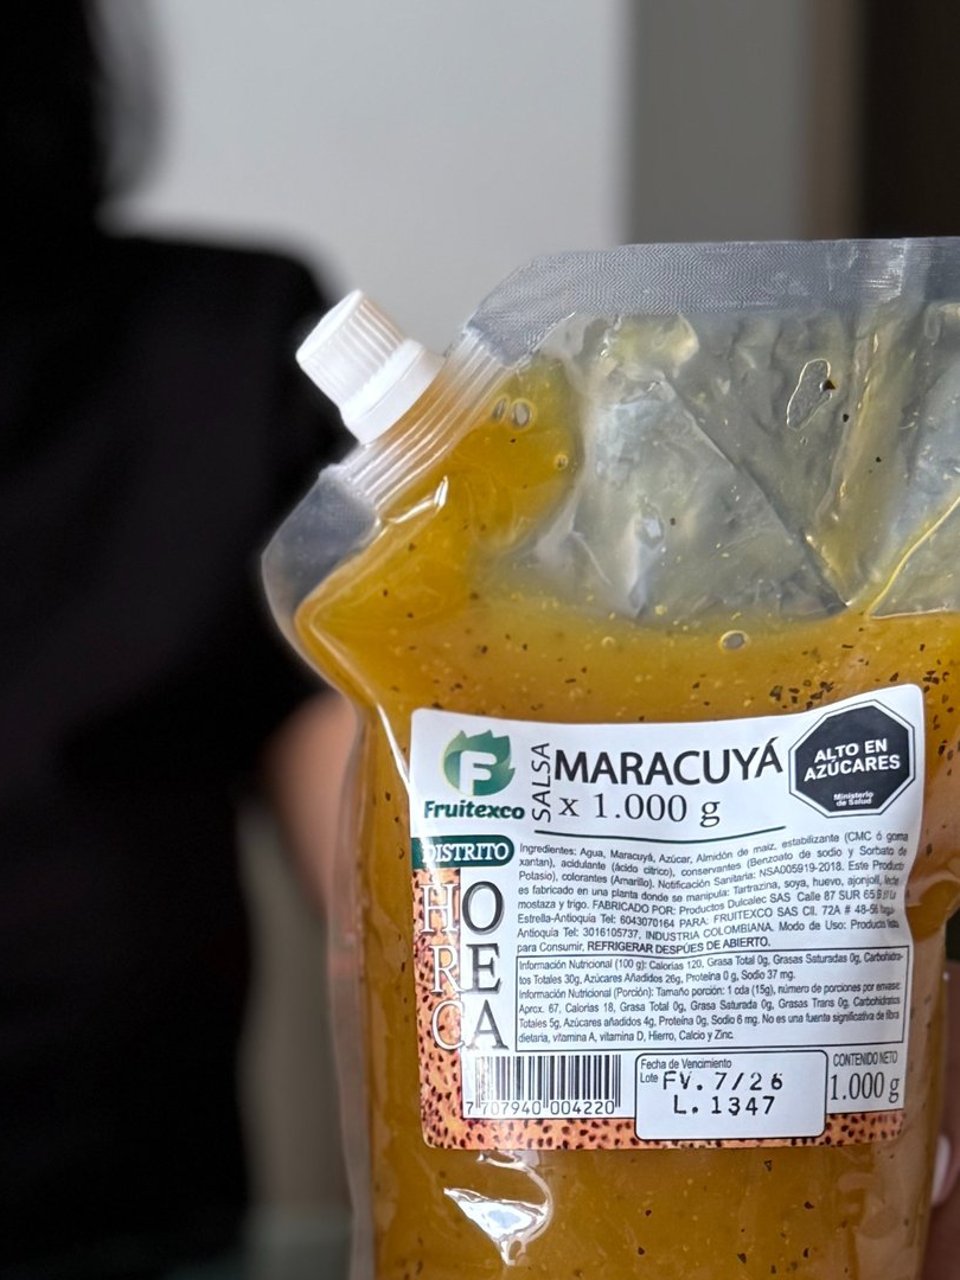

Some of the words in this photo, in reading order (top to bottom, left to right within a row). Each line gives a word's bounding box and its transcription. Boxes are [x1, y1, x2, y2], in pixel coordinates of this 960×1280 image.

[554, 736, 783, 785] MARACUYÁ
[815, 743, 859, 763] ALTO
[865, 739, 887, 754] EN
[803, 755, 900, 782] AZÚCARES
[531, 743, 551, 823] SALSA
[833, 791, 874, 801] Ministerio
[424, 800, 525, 820] Fruitexco
[559, 798, 579, 817] x
[595, 793, 687, 822] 1.000
[700, 801, 720, 828] g
[422, 842, 509, 864] DISTRITO
[520, 843, 576, 856] Ingredientes:
[580, 848, 605, 859] Agua,
[610, 850, 656, 863] Maracuyá,
[659, 855, 692, 864] Azúcar,
[696, 851, 732, 862] Almidón
[737, 848, 749, 857] de
[782, 834, 839, 848] estabilizante
[845, 832, 872, 843] (CMC
[886, 833, 908, 843] goma
[519, 871, 558, 882] Potasio),
[562, 874, 607, 883] colorantes
[610, 875, 654, 889] (Amarillo).
[658, 880, 710, 889] Notificación
[714, 872, 755, 885] Sanitaria:
[848, 861, 868, 870] Este
[517, 928, 559, 939] Antioquia
[564, 927, 578, 937] Tel:
[646, 931, 699, 941] INDUSTRIA
[779, 921, 805, 931] Modo
[809, 920, 820, 930] de
[825, 920, 846, 930] Uso:
[517, 944, 537, 953] para
[539, 942, 584, 951] Consumir,
[587, 941, 652, 953] REFRIGERAR
[656, 942, 704, 954] DESPÚES
[707, 938, 721, 949] DE
[723, 936, 771, 948] ABIERTO.
[519, 976, 531, 984] tos
[534, 975, 562, 984] Totales
[564, 974, 582, 986] 30g,
[584, 974, 622, 983] Azúcares
[624, 973, 663, 983] Añadidos
[665, 973, 683, 985] 26g,
[723, 971, 728, 980] 0
[731, 973, 739, 982] g,
[742, 970, 765, 979] Sodio
[767, 970, 777, 979] 37
[780, 971, 795, 981] mg.
[519, 1032, 550, 1043] dietaria,
[553, 1032, 587, 1042] vitamina
[589, 1032, 597, 1042] A,
[600, 1031, 634, 1041] vitamina
[637, 1032, 646, 1042] D,
[648, 1031, 676, 1041] Hierro,
[679, 1030, 705, 1040] Calcio
[707, 1032, 711, 1042] y
[641, 1059, 667, 1069] Fecha
[669, 1060, 679, 1069] de
[681, 1059, 731, 1069] Vencimiento
[833, 1053, 877, 1066] CONTENIDO
[879, 1051, 897, 1064] NETO
[641, 1073, 658, 1083] Lote
[830, 1072, 884, 1100] 1.000
[888, 1077, 900, 1103] g
[466, 1102, 474, 1115] 7
[481, 1102, 540, 1115] 707940
[550, 1101, 614, 1115] 004220
